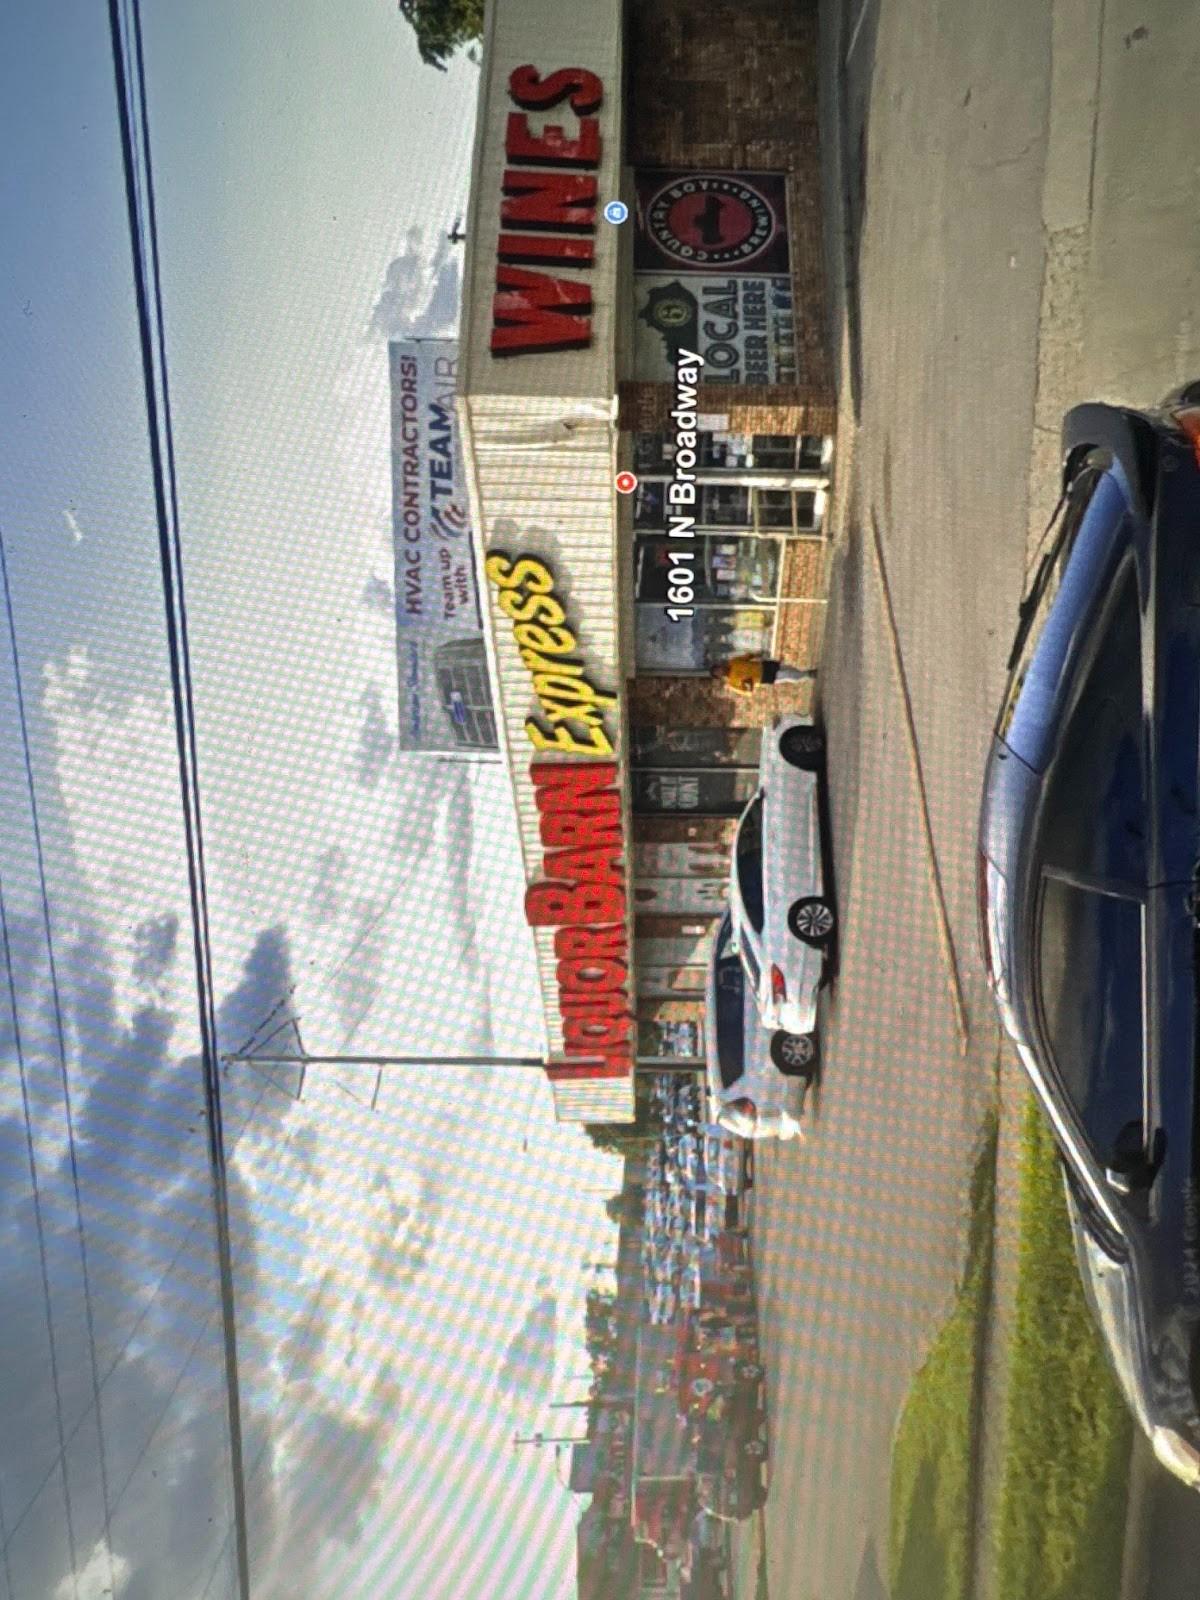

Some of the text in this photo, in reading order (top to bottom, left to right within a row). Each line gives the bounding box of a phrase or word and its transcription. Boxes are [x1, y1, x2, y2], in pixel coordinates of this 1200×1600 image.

[490, 64, 604, 358] WINES
[651, 180, 709, 260] COUNTRY BOY
[738, 190, 769, 254] BREWING
[702, 280, 740, 384] LOCAL
[742, 280, 768, 384] BEER HERE
[400, 355, 421, 615] HVAC CONTRACTORS!
[437, 548, 456, 620] Team up
[454, 565, 469, 606] with
[484, 551, 617, 756] Express
